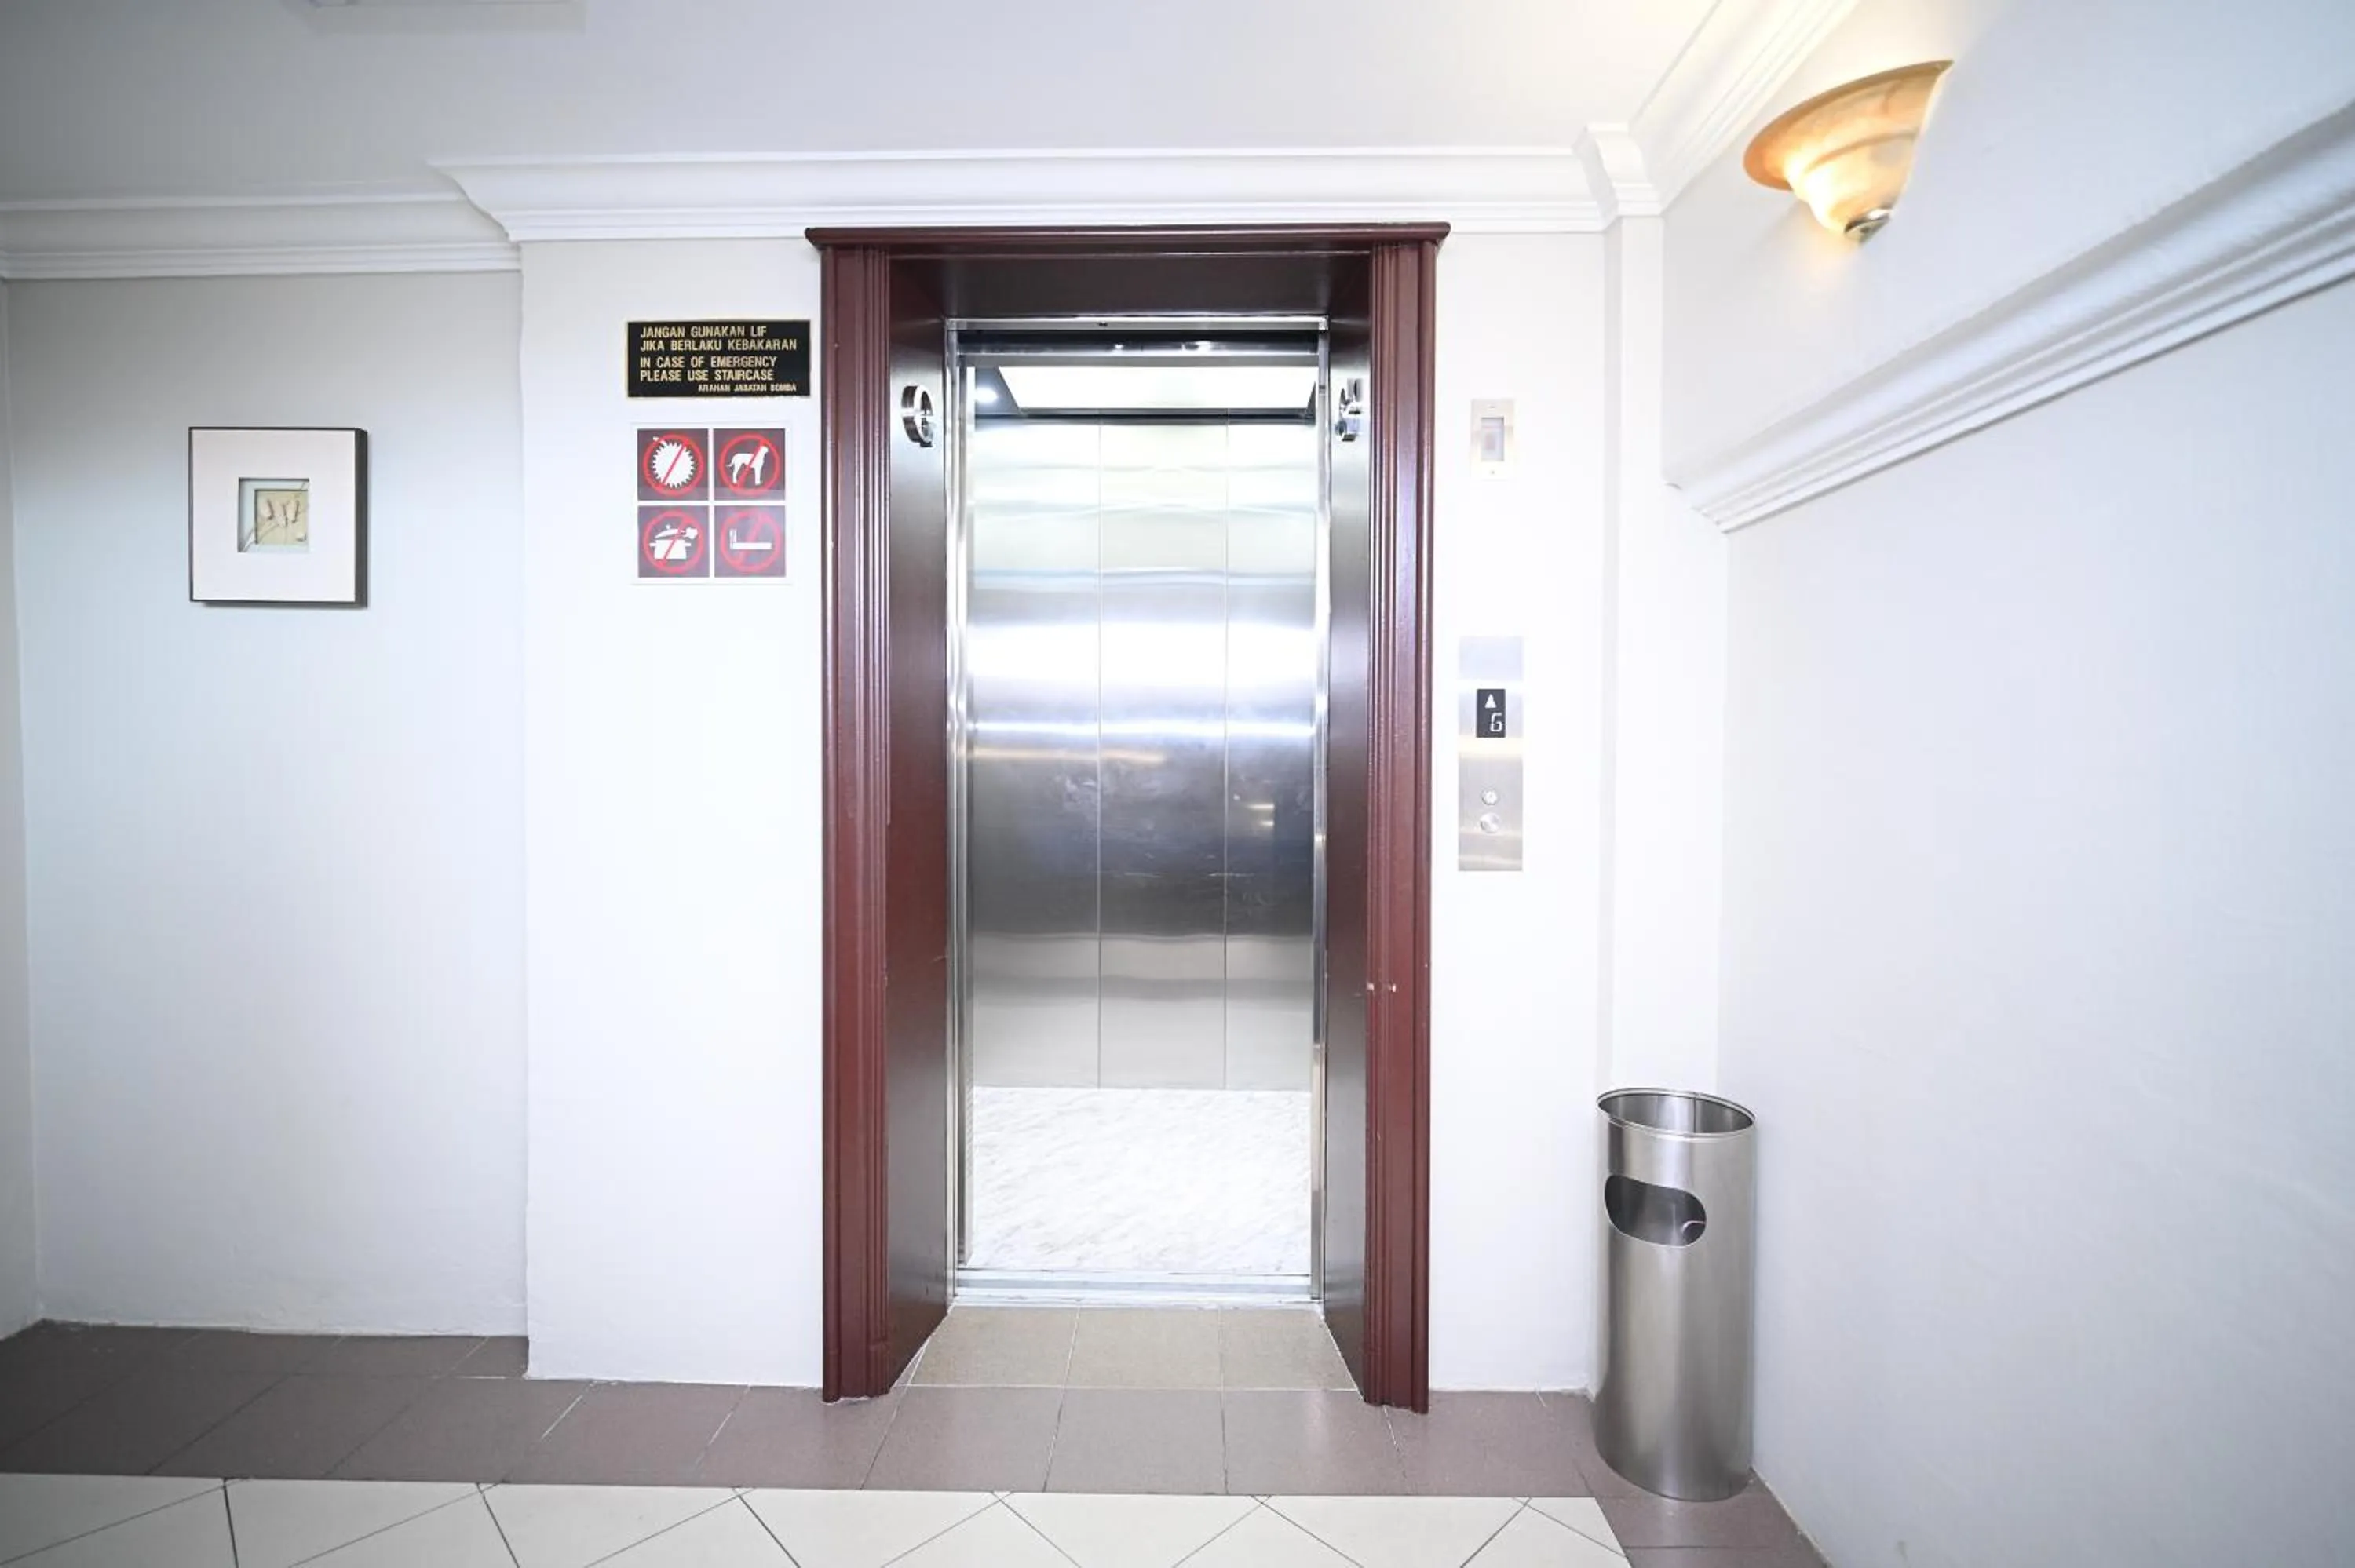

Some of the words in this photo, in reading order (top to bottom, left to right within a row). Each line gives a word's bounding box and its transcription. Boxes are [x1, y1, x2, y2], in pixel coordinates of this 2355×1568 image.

[640, 326, 685, 338] JANGAN
[691, 326, 744, 337] GUNAKAN
[750, 326, 767, 337] LIF
[640, 339, 665, 352] JIKA
[670, 338, 721, 351] BERLAKU
[728, 338, 797, 351] KEBAKARAN
[640, 356, 650, 368] IN
[656, 356, 685, 368] CASE
[691, 356, 705, 368] OF
[711, 356, 777, 368] EMERGENCY
[640, 370, 681, 382] PLEASE
[688, 369, 709, 381] USE
[714, 369, 774, 381] STAIRCASE
